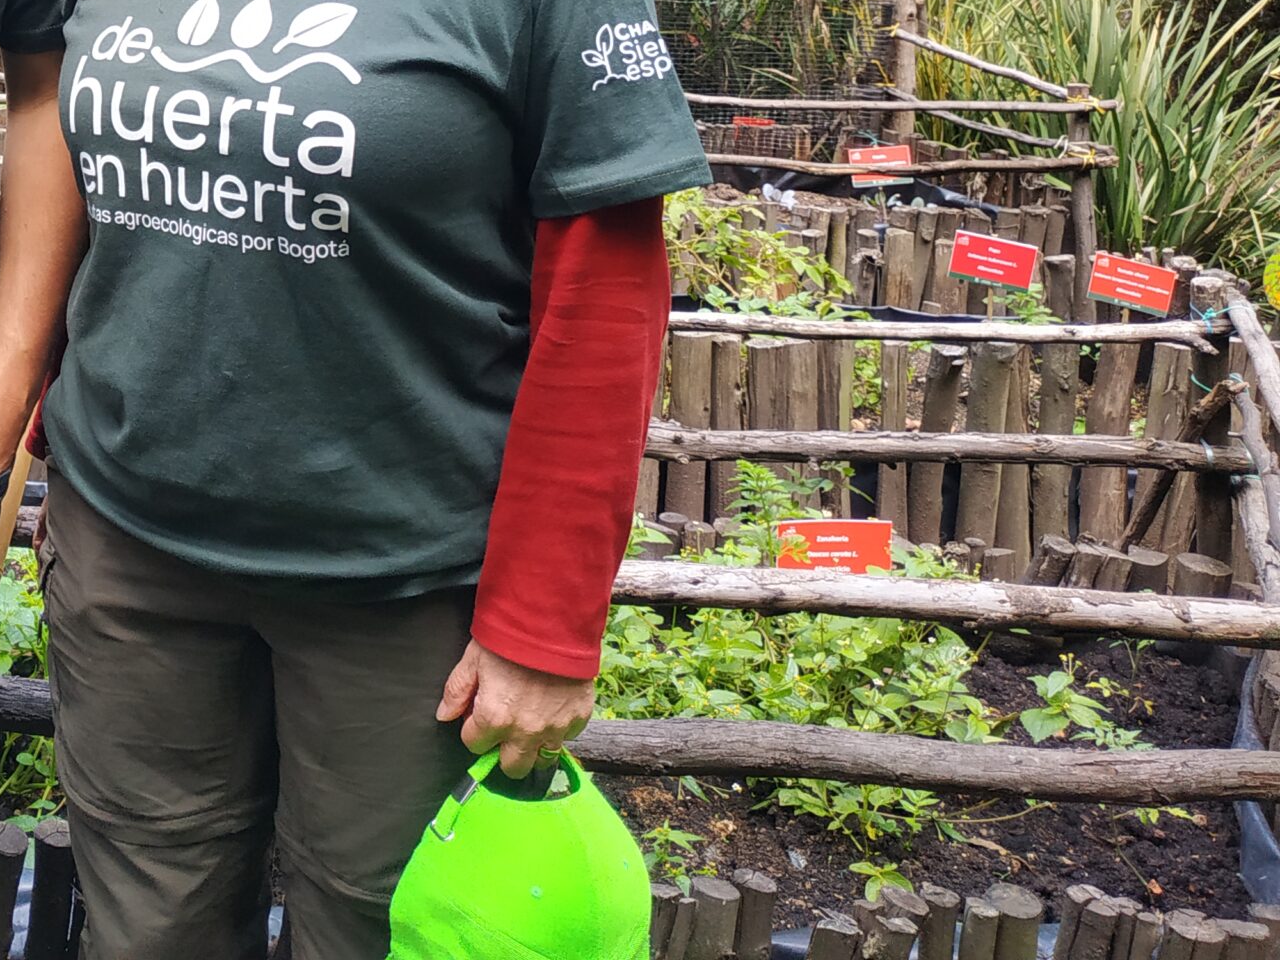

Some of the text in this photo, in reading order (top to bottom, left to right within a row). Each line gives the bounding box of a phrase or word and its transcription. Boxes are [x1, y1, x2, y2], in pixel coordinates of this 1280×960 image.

[92, 16, 153, 63] de
[70, 56, 357, 177] huerta
[80, 148, 350, 233] en huerta
[115, 209, 238, 245] agroecológicas
[242, 232, 274, 253] por
[279, 237, 349, 264] Bogotá
